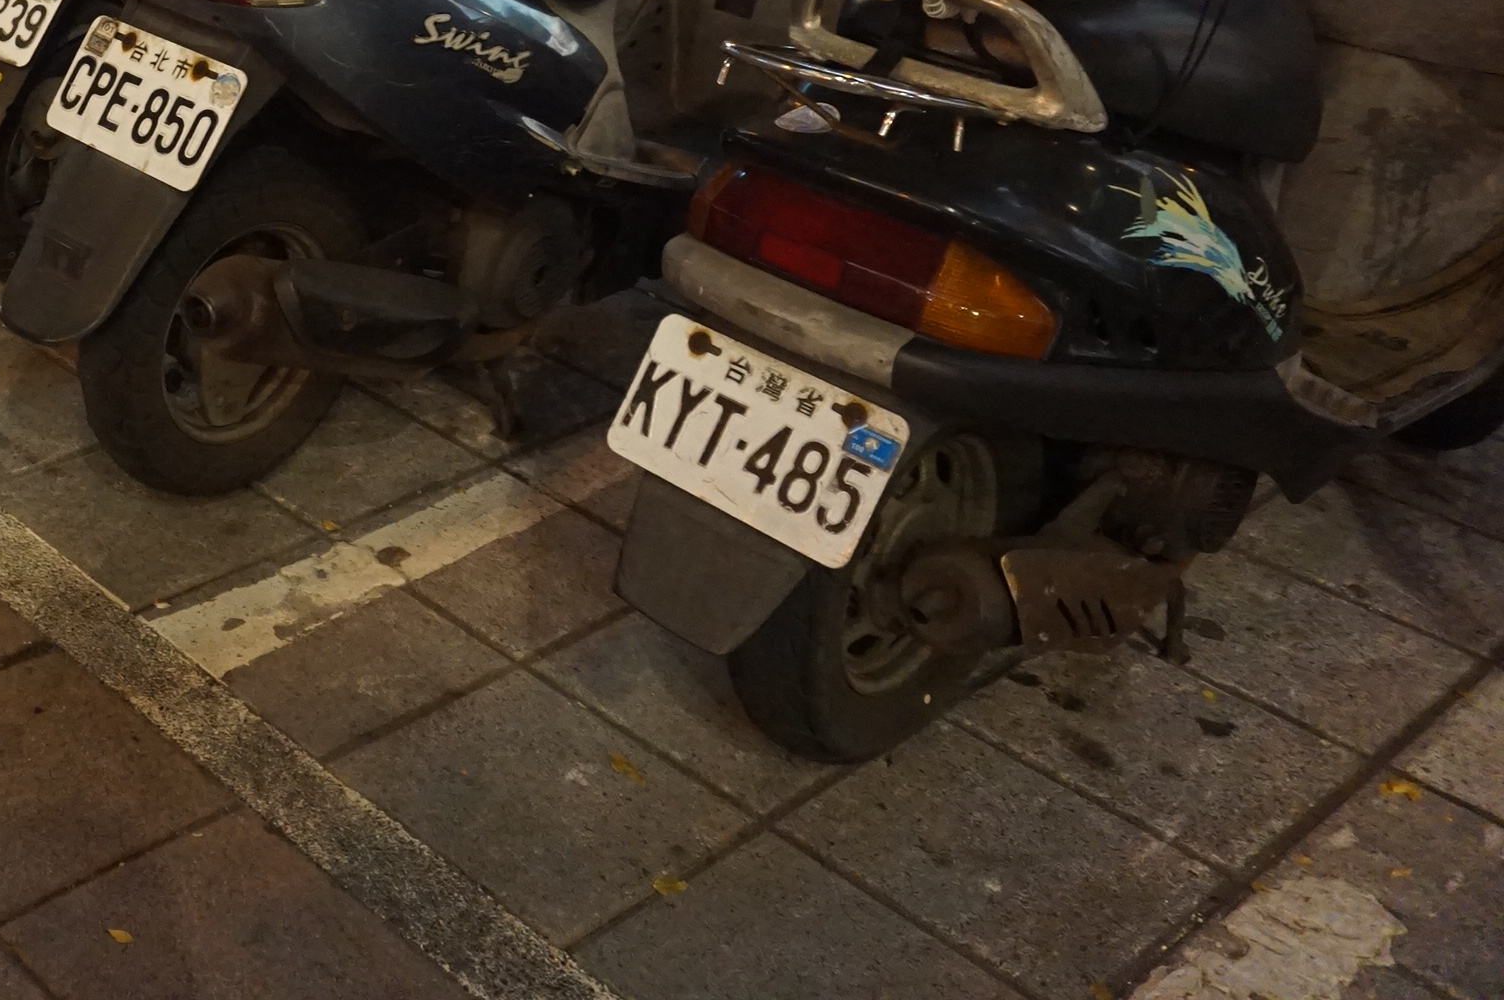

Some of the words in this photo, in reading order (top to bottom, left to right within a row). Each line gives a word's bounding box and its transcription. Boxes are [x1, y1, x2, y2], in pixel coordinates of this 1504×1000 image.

[60, 55, 219, 167] CPE-850
[129, 41, 193, 80] 台北市
[622, 360, 874, 535] KYT-485
